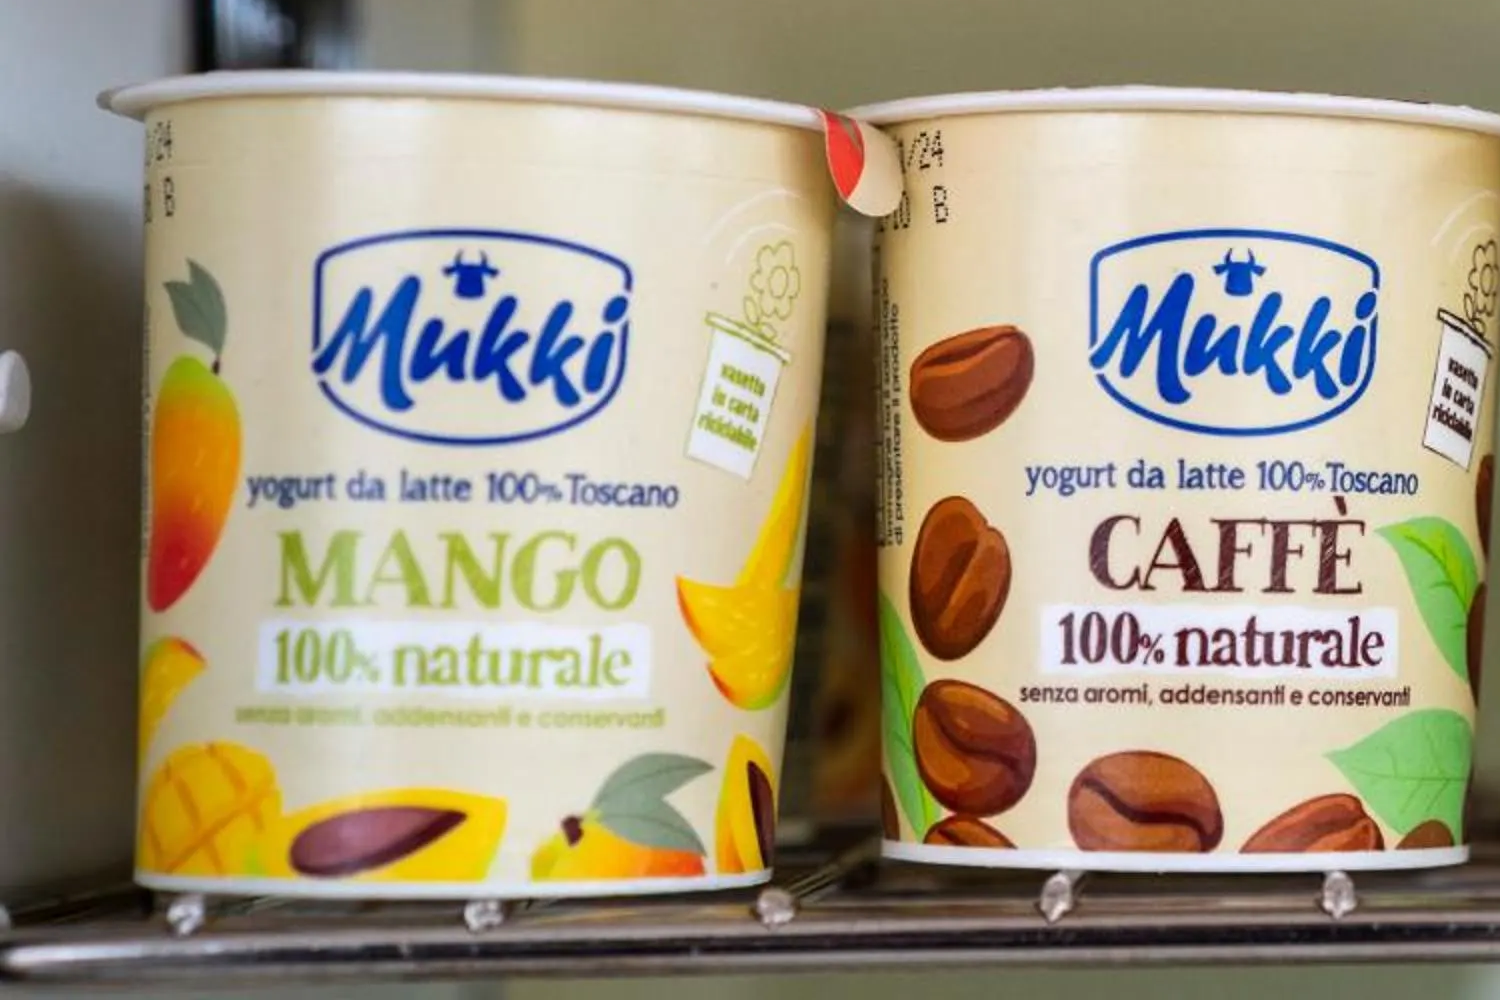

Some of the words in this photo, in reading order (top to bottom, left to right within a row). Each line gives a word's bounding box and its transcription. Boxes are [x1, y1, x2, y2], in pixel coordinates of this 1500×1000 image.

[312, 271, 630, 412] Mukki
[1091, 270, 1378, 403] Mukki
[246, 472, 335, 509] yogurt
[346, 471, 385, 501] da
[400, 470, 471, 501] latte
[1025, 461, 1116, 496] yogurt
[1127, 460, 1165, 489] da
[1178, 459, 1245, 490] latte
[274, 528, 642, 613] MANGO
[1088, 496, 1366, 595] CAFFÈ
[274, 627, 380, 685] 100%
[391, 631, 633, 688] naturale
[1058, 611, 1165, 667] 100%
[1173, 614, 1385, 669] naturale
[1020, 686, 1079, 704] senza
[1083, 682, 1153, 706] aromi,
[1158, 682, 1285, 705] addensanti
[1291, 688, 1302, 705] e
[1308, 684, 1411, 707] conservanti
